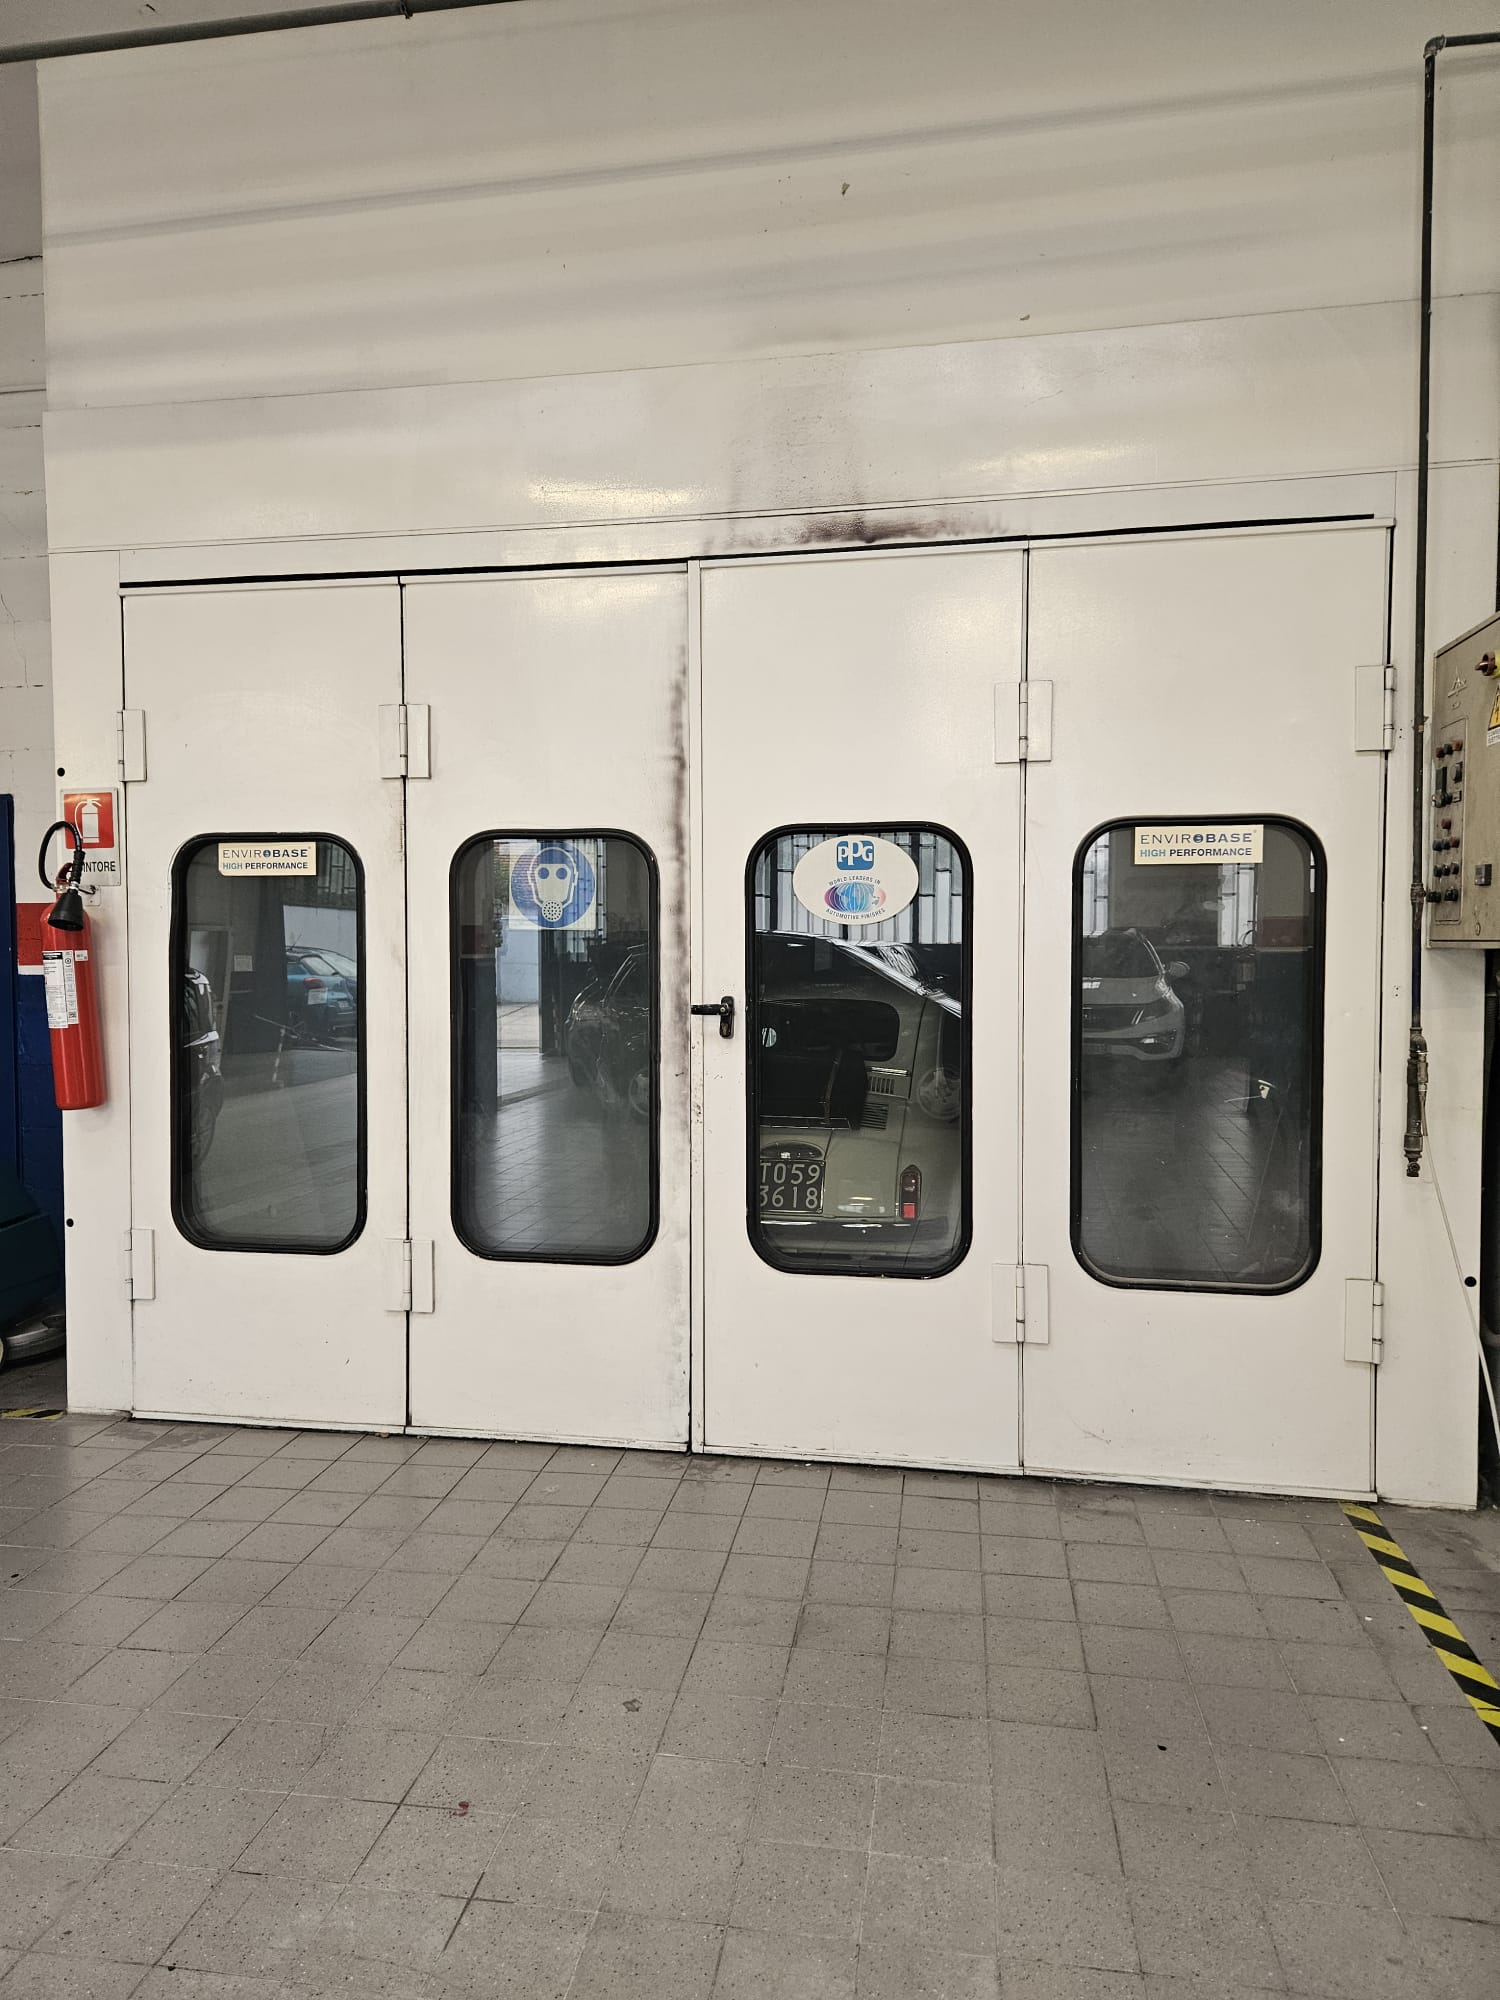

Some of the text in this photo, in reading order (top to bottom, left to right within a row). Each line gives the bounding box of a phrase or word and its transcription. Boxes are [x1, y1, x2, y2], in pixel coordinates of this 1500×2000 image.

[837, 841, 873, 866] PPG
[1140, 848, 1252, 857] HIGH PERFORMANCE
[82, 861, 116, 873] INTORE
[223, 861, 308, 870] HIGH PERFORMANCE
[760, 1186, 818, 1209] 3618
